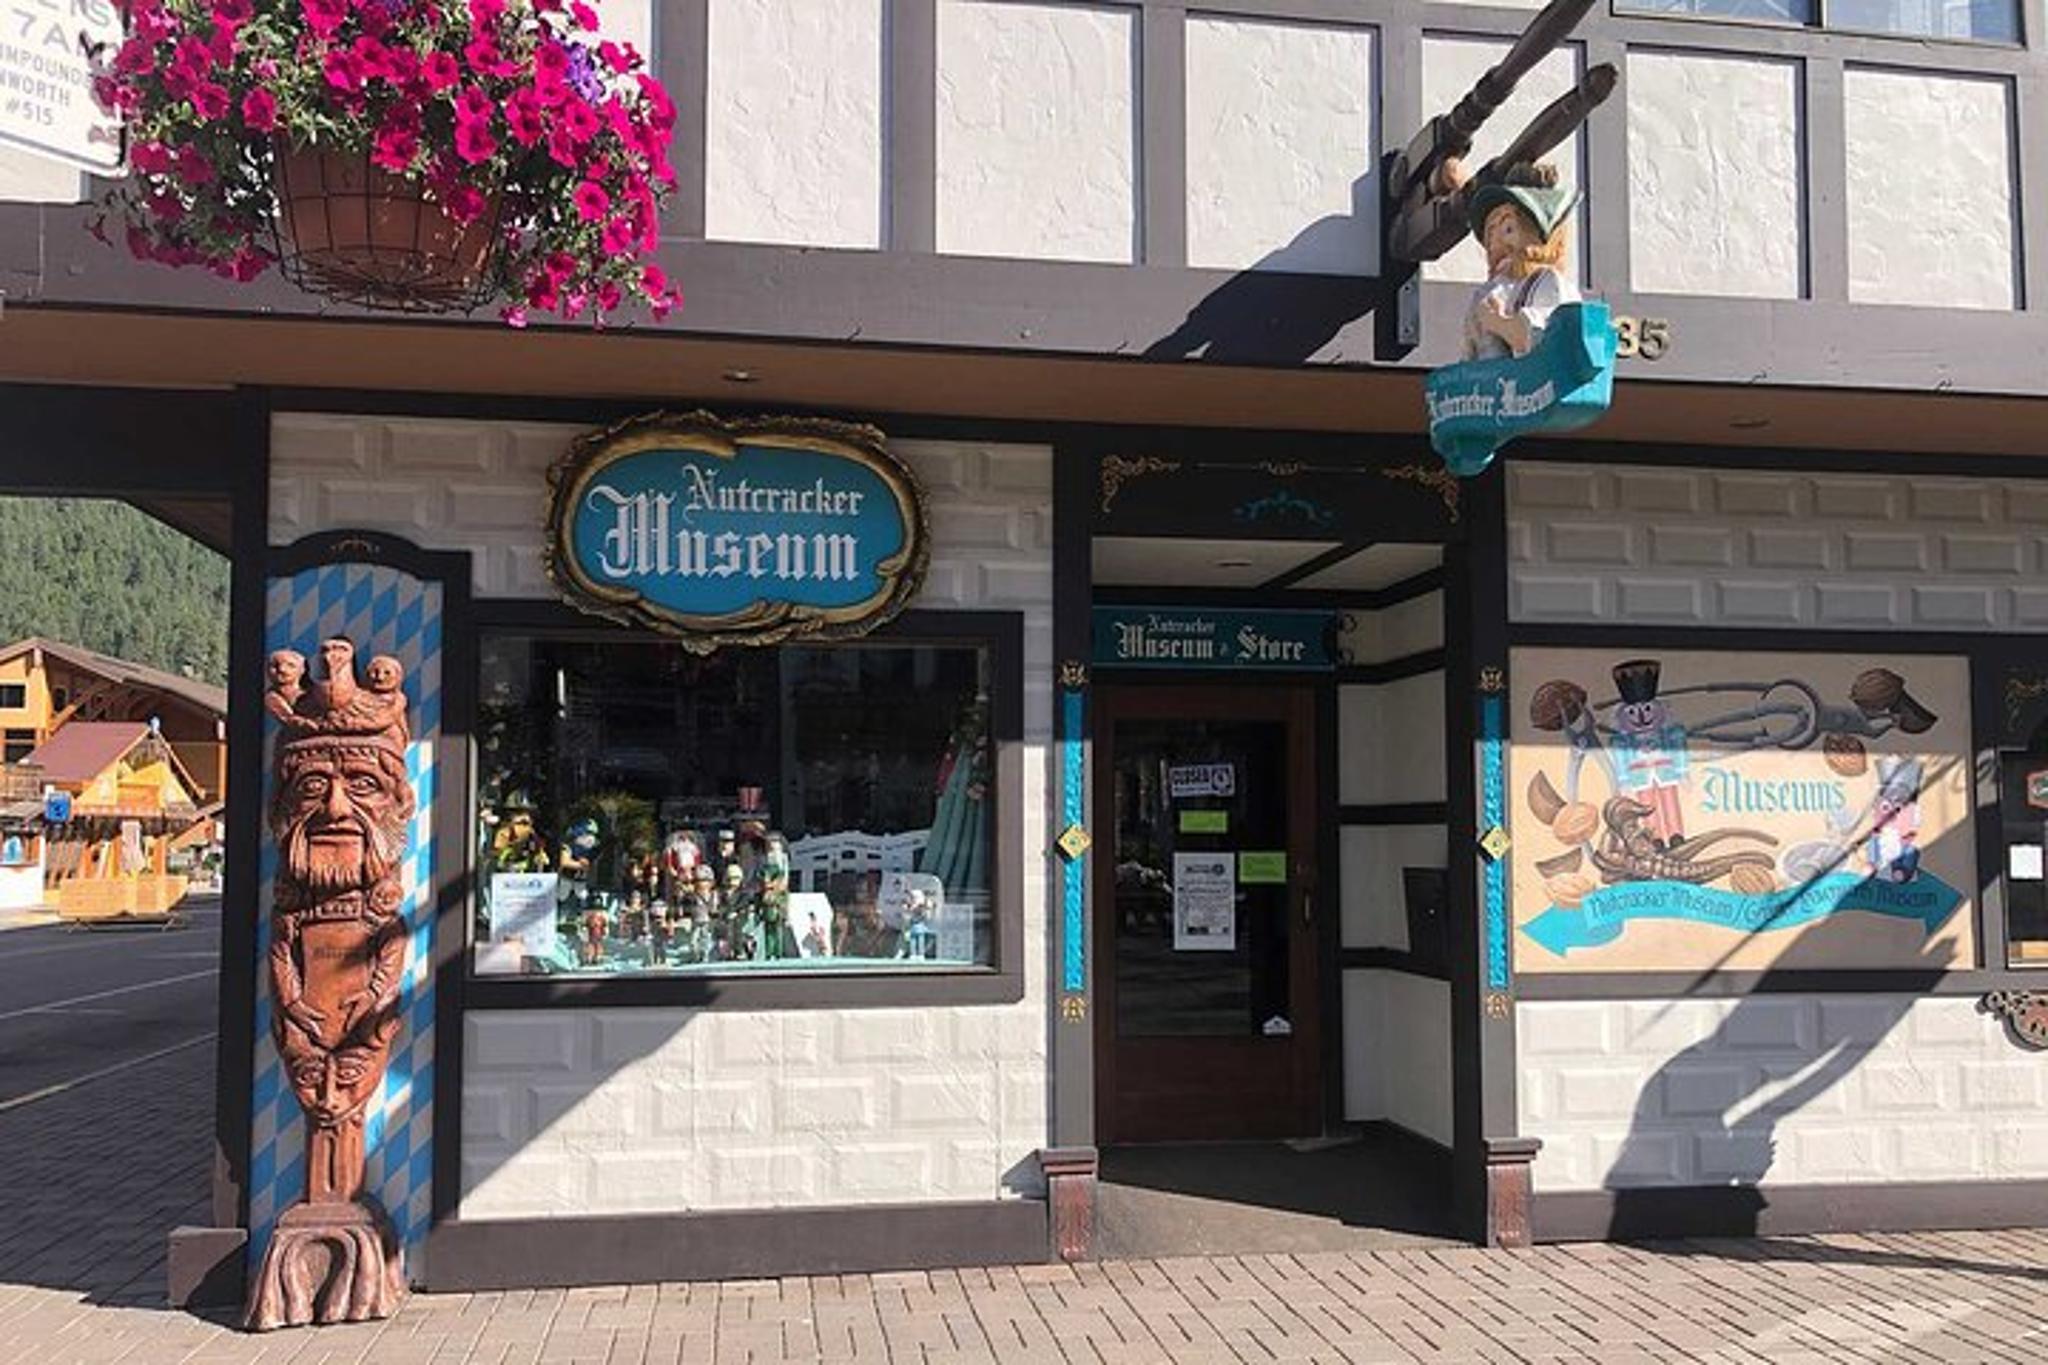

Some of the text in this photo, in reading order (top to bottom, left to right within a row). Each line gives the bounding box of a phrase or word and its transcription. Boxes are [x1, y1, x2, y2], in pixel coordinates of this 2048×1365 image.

[1614, 316, 1670, 360] 35
[682, 463, 864, 524] Nutcracker
[587, 484, 860, 582] Museum
[1113, 622, 1213, 659] Museum
[1234, 625, 1307, 665] Store
[1147, 614, 1216, 634] Nutcracker
[1701, 767, 1847, 814] Museums
